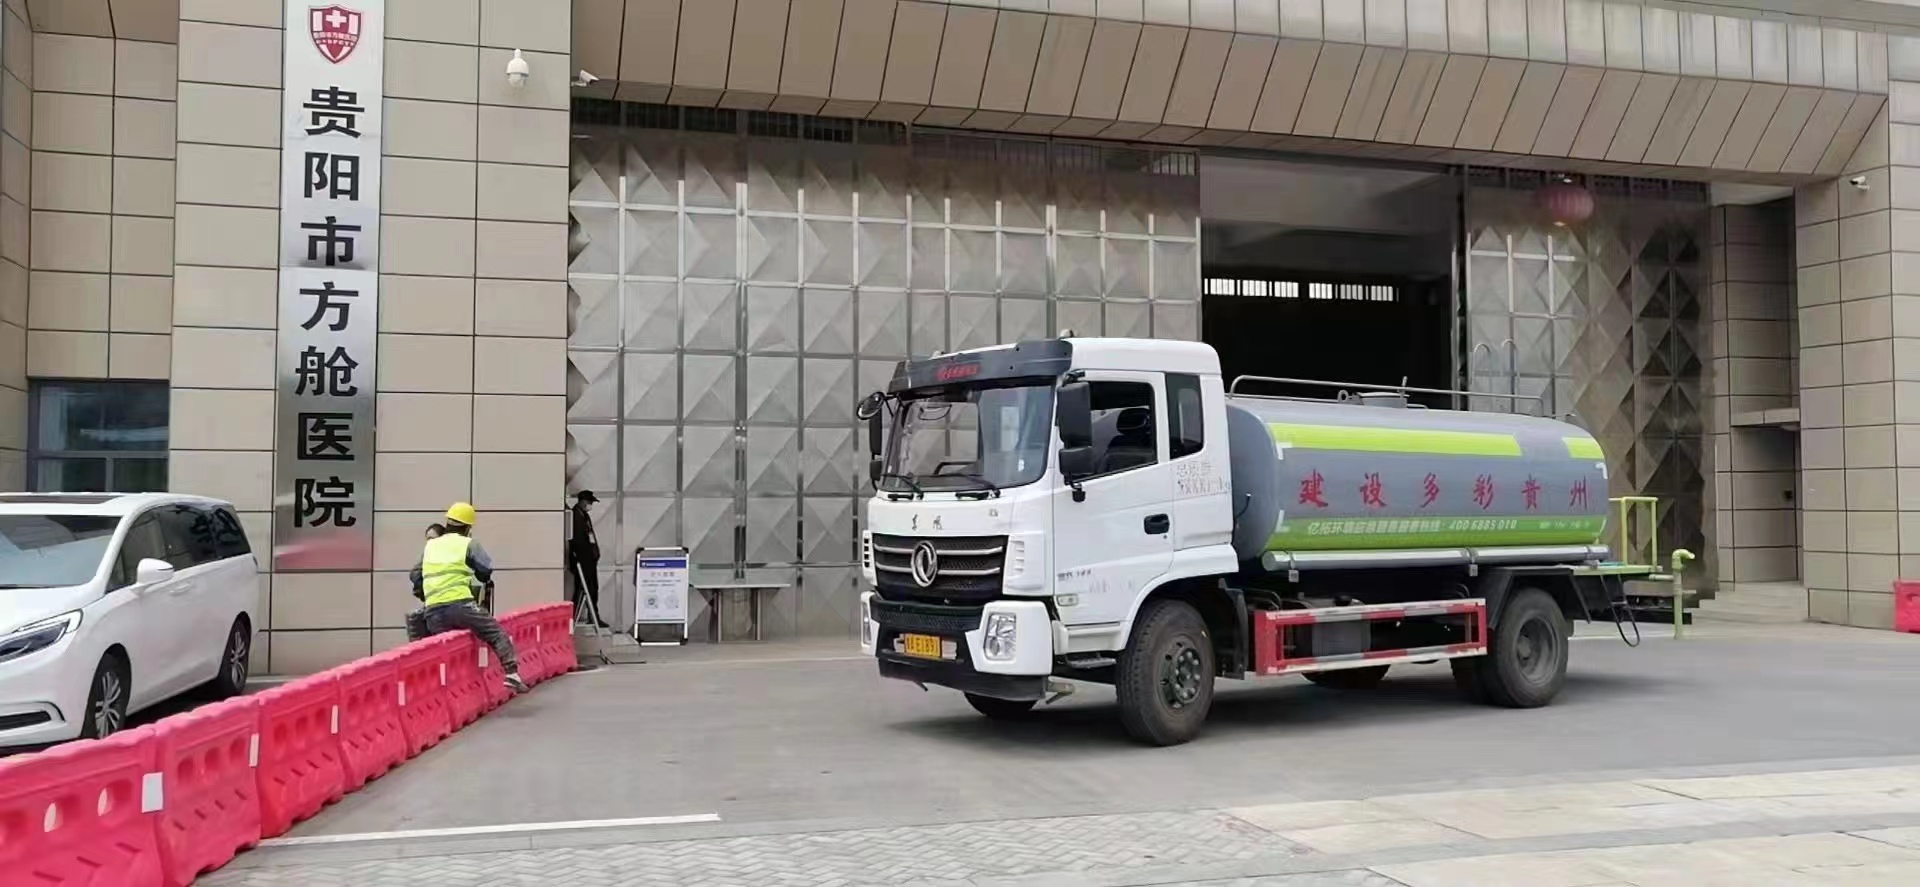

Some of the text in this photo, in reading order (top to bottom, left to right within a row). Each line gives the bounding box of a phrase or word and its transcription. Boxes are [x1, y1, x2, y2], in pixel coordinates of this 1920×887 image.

[293, 86, 365, 529] 贵阳市方舱医院
